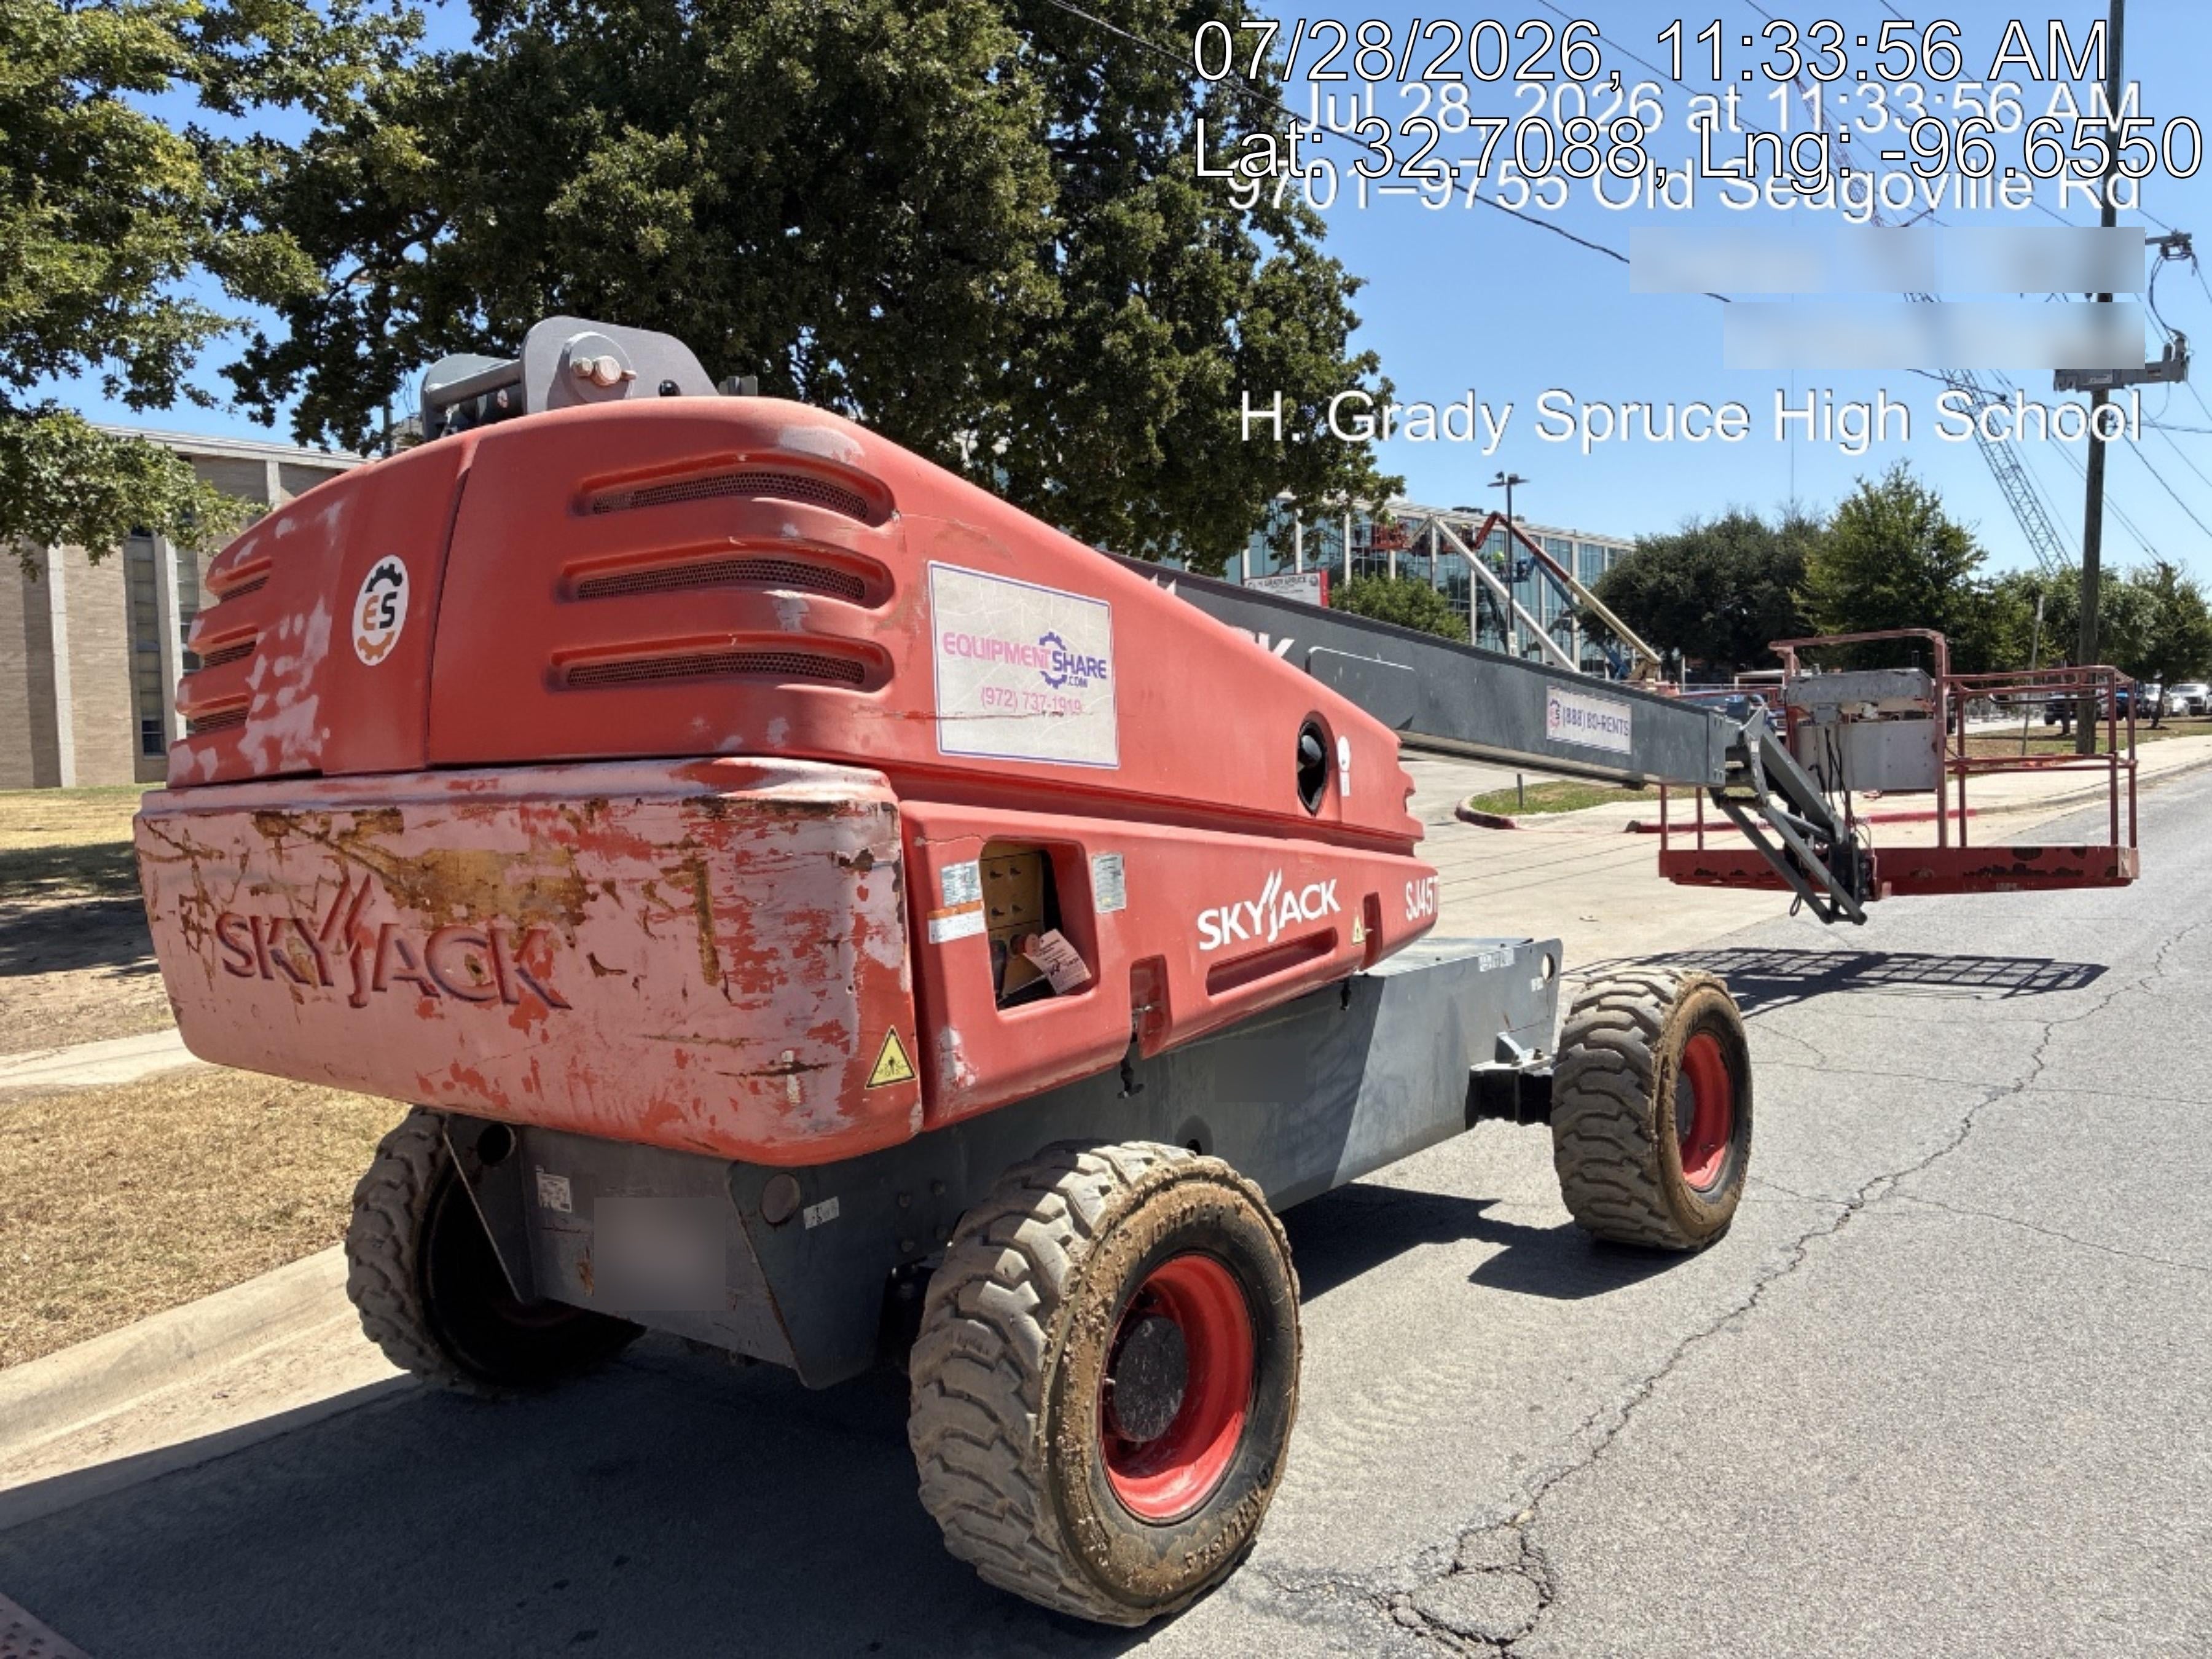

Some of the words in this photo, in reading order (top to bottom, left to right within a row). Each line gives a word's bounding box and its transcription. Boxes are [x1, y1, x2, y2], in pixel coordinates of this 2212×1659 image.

[981, 687, 1018, 713] (972)
[216, 873, 572, 1011] SKYJACK
[1198, 867, 1341, 951] SKYJACK
